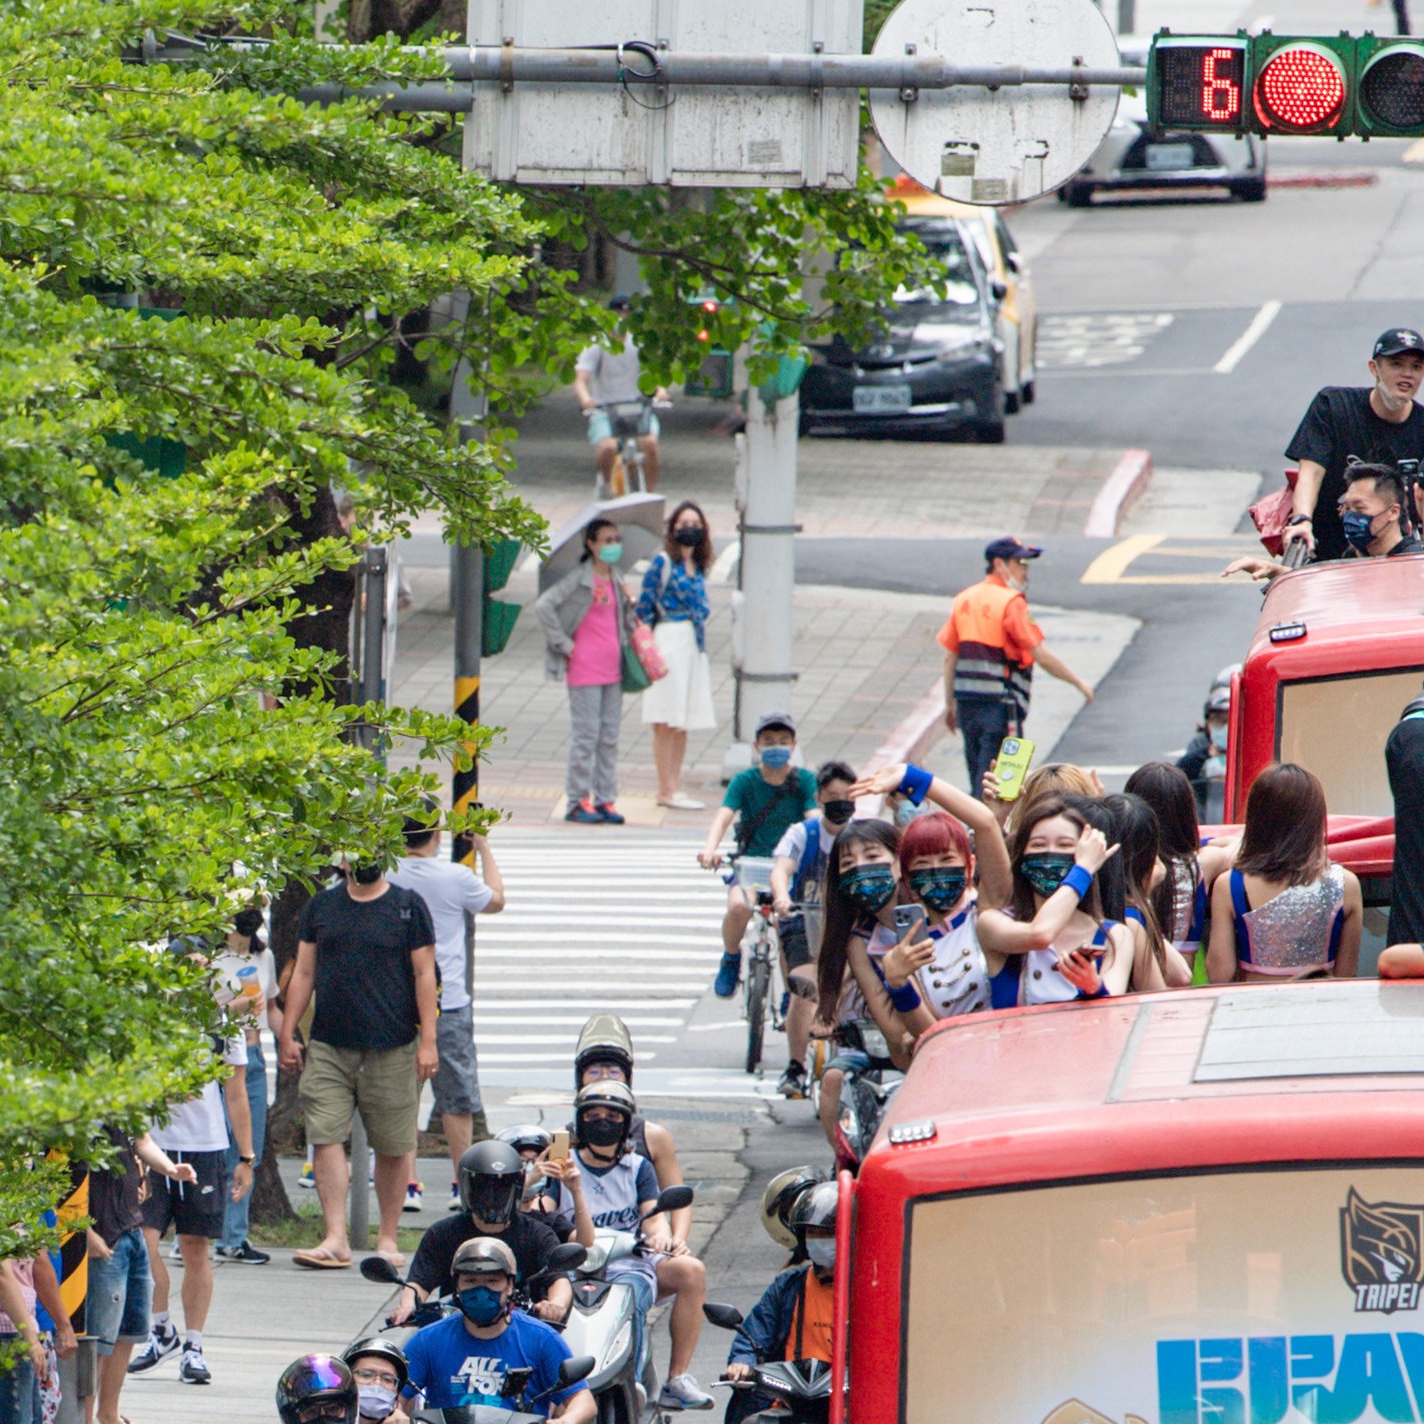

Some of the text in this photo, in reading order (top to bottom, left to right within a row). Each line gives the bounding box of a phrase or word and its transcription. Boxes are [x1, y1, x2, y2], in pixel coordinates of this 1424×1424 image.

[1202, 49, 1238, 119] 6
[1356, 1283, 1419, 1310] TAIPEI
[458, 1356, 504, 1378] ALL
